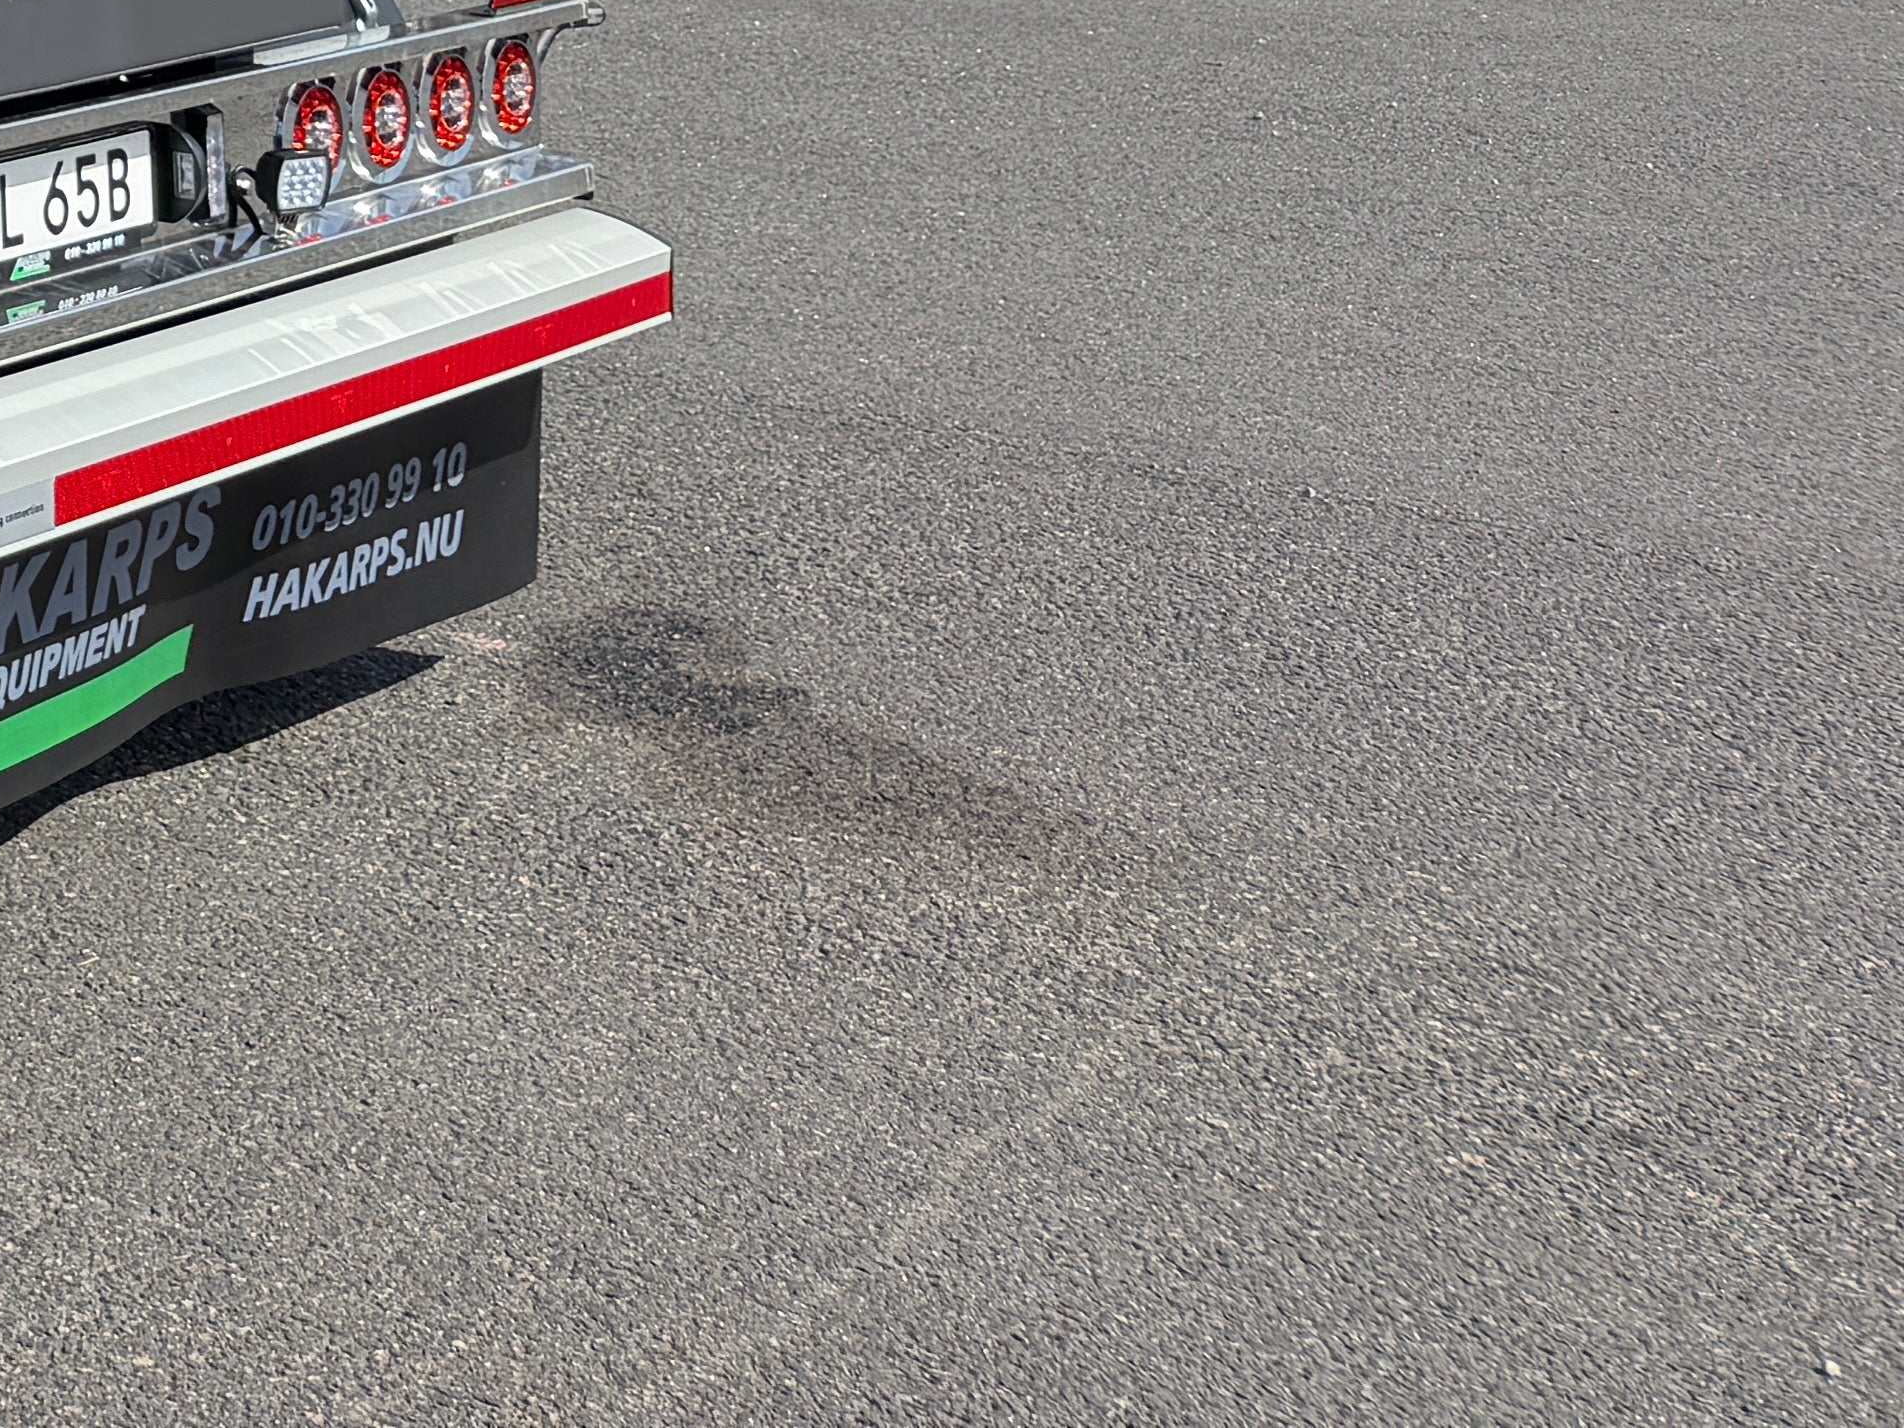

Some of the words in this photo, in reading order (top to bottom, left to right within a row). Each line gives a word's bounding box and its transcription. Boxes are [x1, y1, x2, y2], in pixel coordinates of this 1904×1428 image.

[43, 147, 130, 236] 65B
[251, 475, 383, 552] 010-330
[383, 462, 423, 507] 99
[430, 441, 468, 491] 10
[242, 509, 466, 623] HAKARPS.NU
